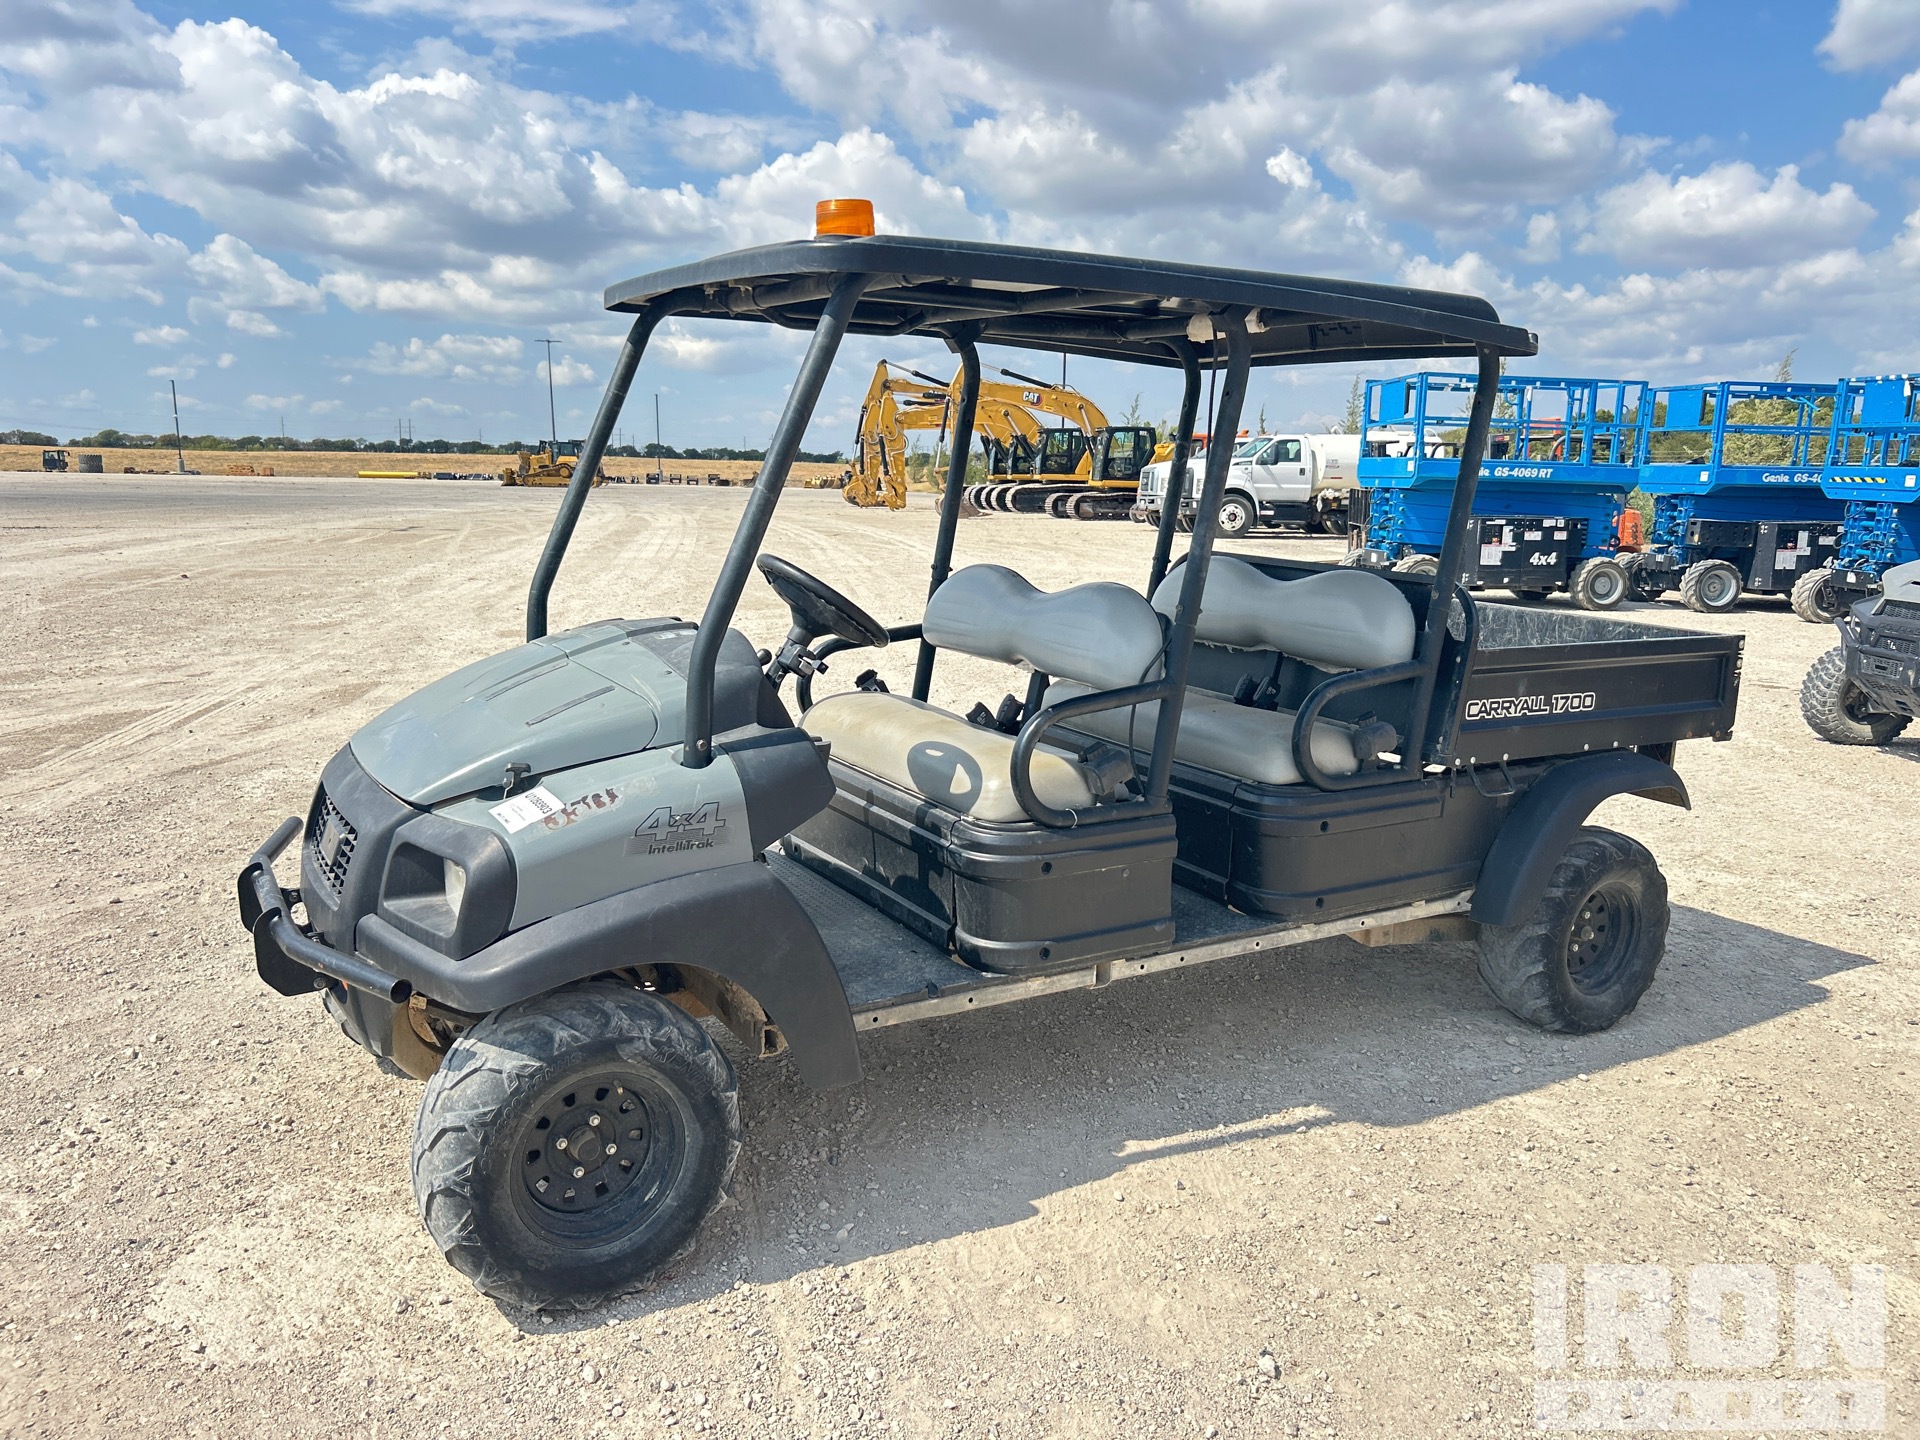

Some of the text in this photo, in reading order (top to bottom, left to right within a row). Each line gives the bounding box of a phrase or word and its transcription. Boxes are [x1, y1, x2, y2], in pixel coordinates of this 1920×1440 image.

[1023, 391, 1039, 403] CAT
[1494, 467, 1538, 478] GS-4069
[1538, 468, 1553, 478] RT
[1762, 473, 1791, 483] Genie
[1529, 552, 1557, 565] 4x4
[1465, 692, 1596, 720] CARRYALL 1700
[635, 802, 727, 842] 4x4
[648, 838, 715, 855] IntelliTrak
